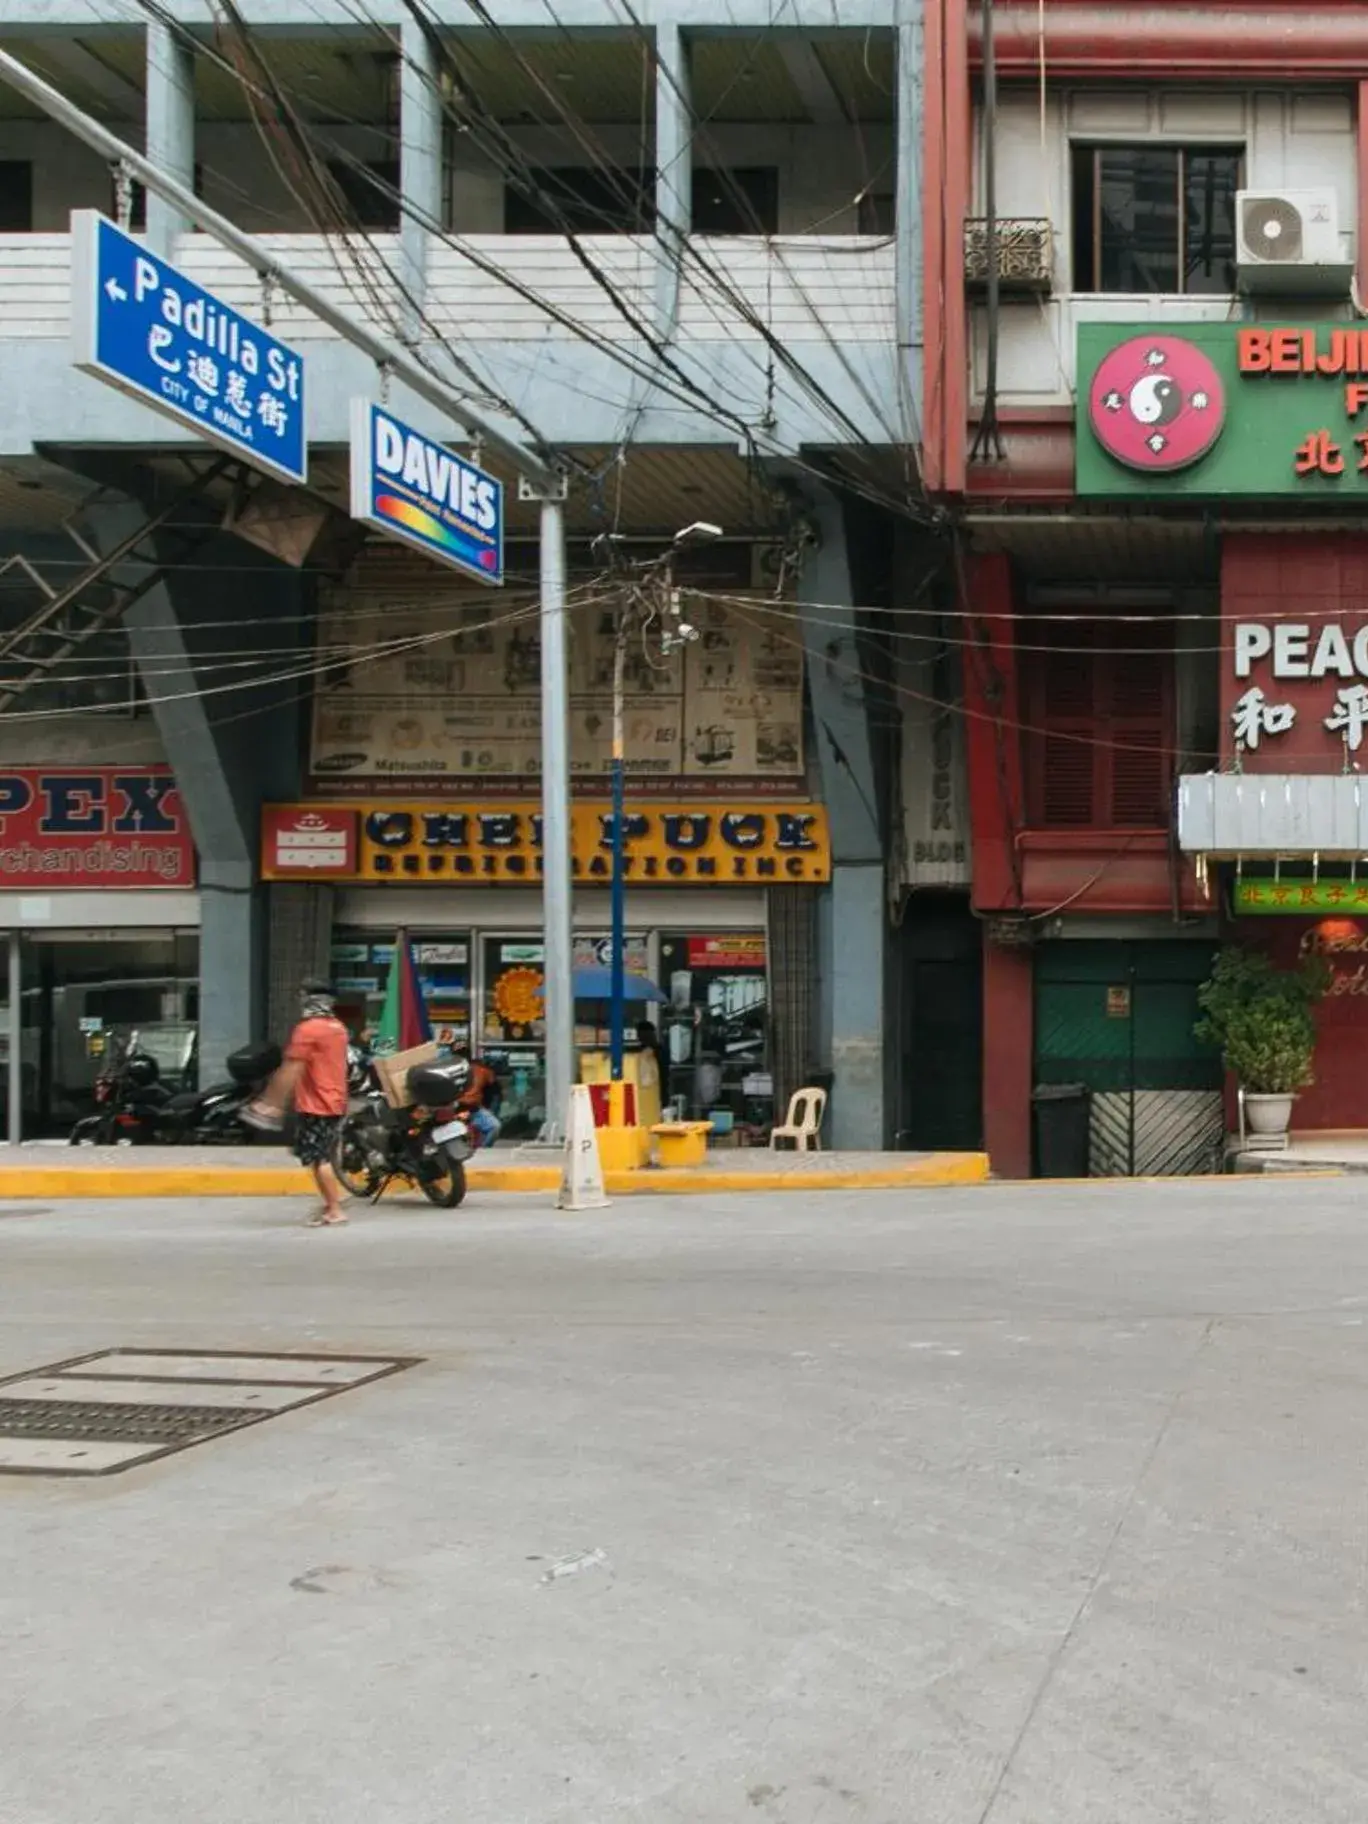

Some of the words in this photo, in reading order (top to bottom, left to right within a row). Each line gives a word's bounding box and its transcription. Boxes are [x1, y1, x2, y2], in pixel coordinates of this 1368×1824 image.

[135, 257, 258, 375] Padilla
[267, 347, 299, 401] St
[161, 376, 190, 403] CITY
[376, 414, 496, 529] DAVIES
[0, 841, 182, 879] chandising
